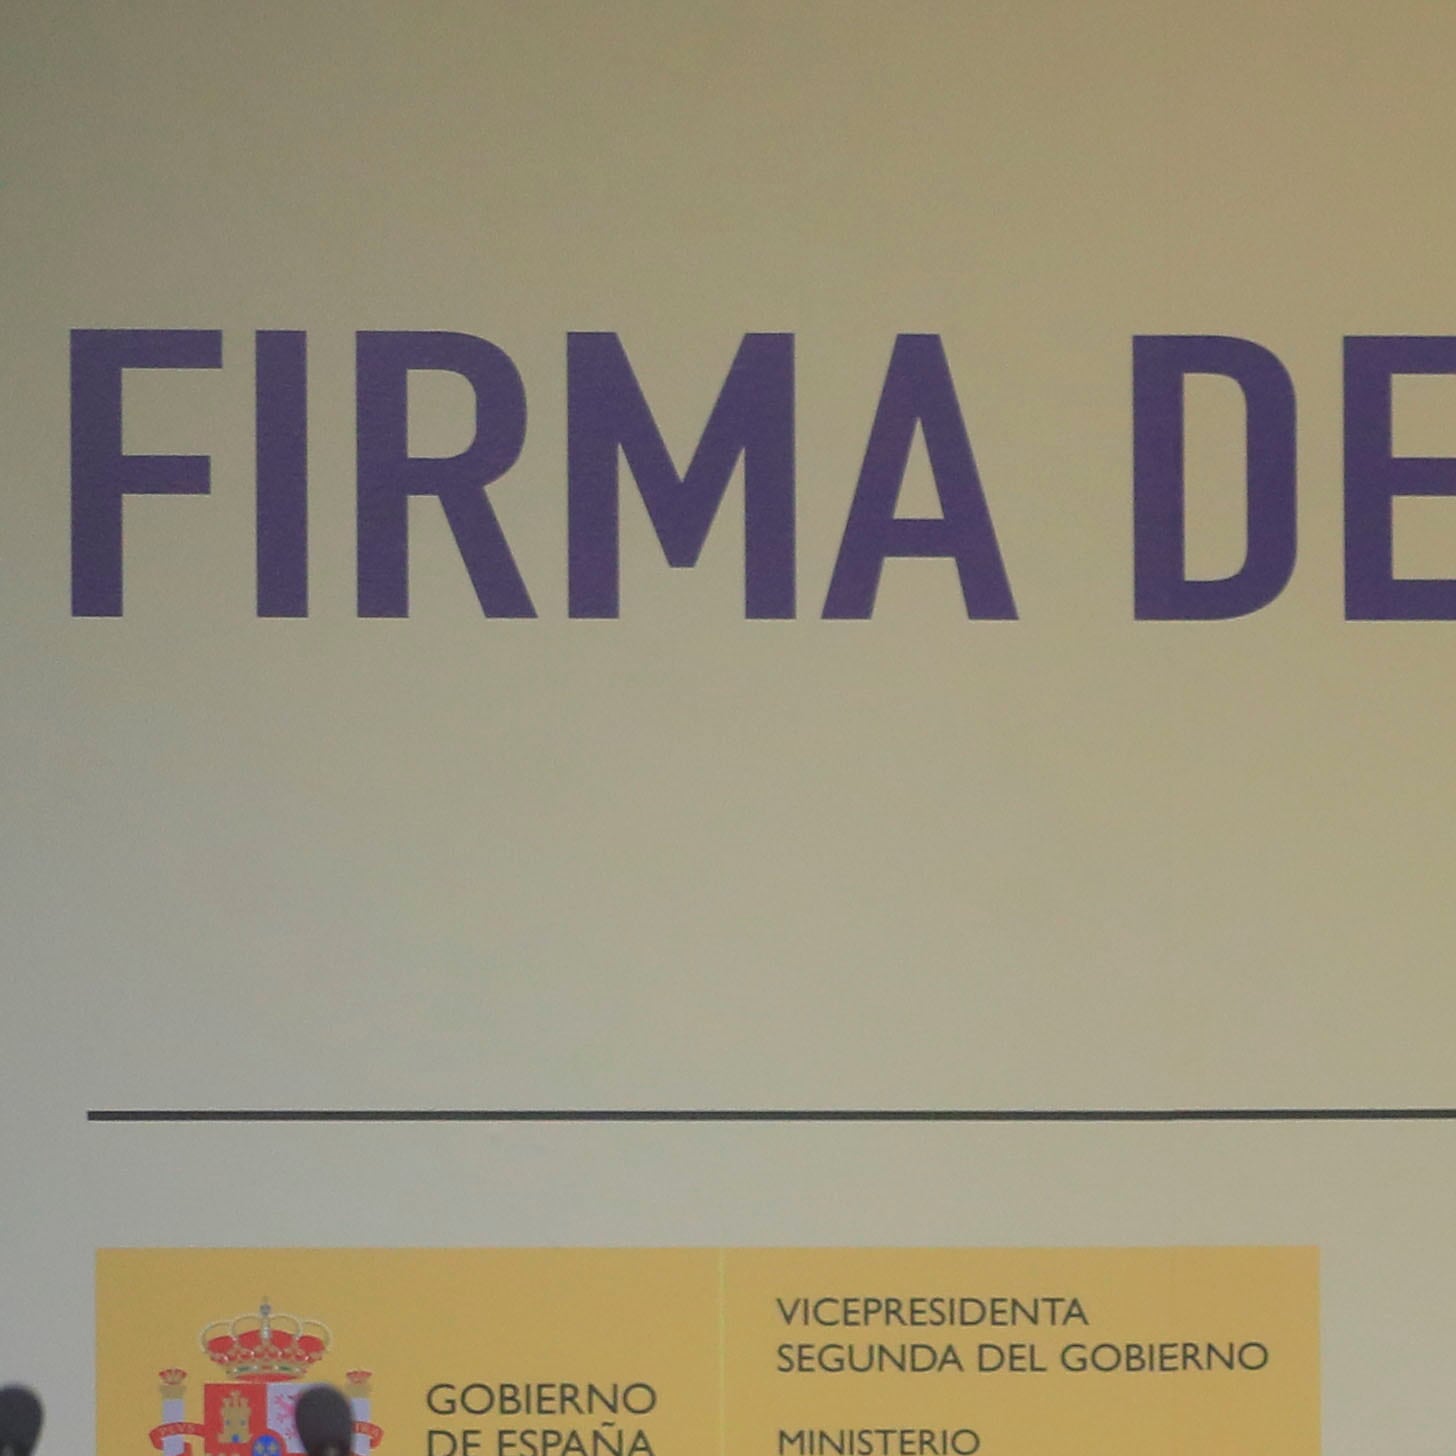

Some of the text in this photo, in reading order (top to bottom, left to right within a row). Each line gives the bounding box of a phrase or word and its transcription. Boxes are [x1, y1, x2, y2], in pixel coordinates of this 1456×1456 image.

[70, 329, 1017, 619] FIRMA
[777, 1298, 1088, 1326] VICEPRESIDENTA
[778, 1342, 1268, 1372] SEGUNDA DEL GOBIERNO
[427, 1383, 656, 1415] GOBIERNO
[779, 1429, 980, 1455] MINISTERIO
